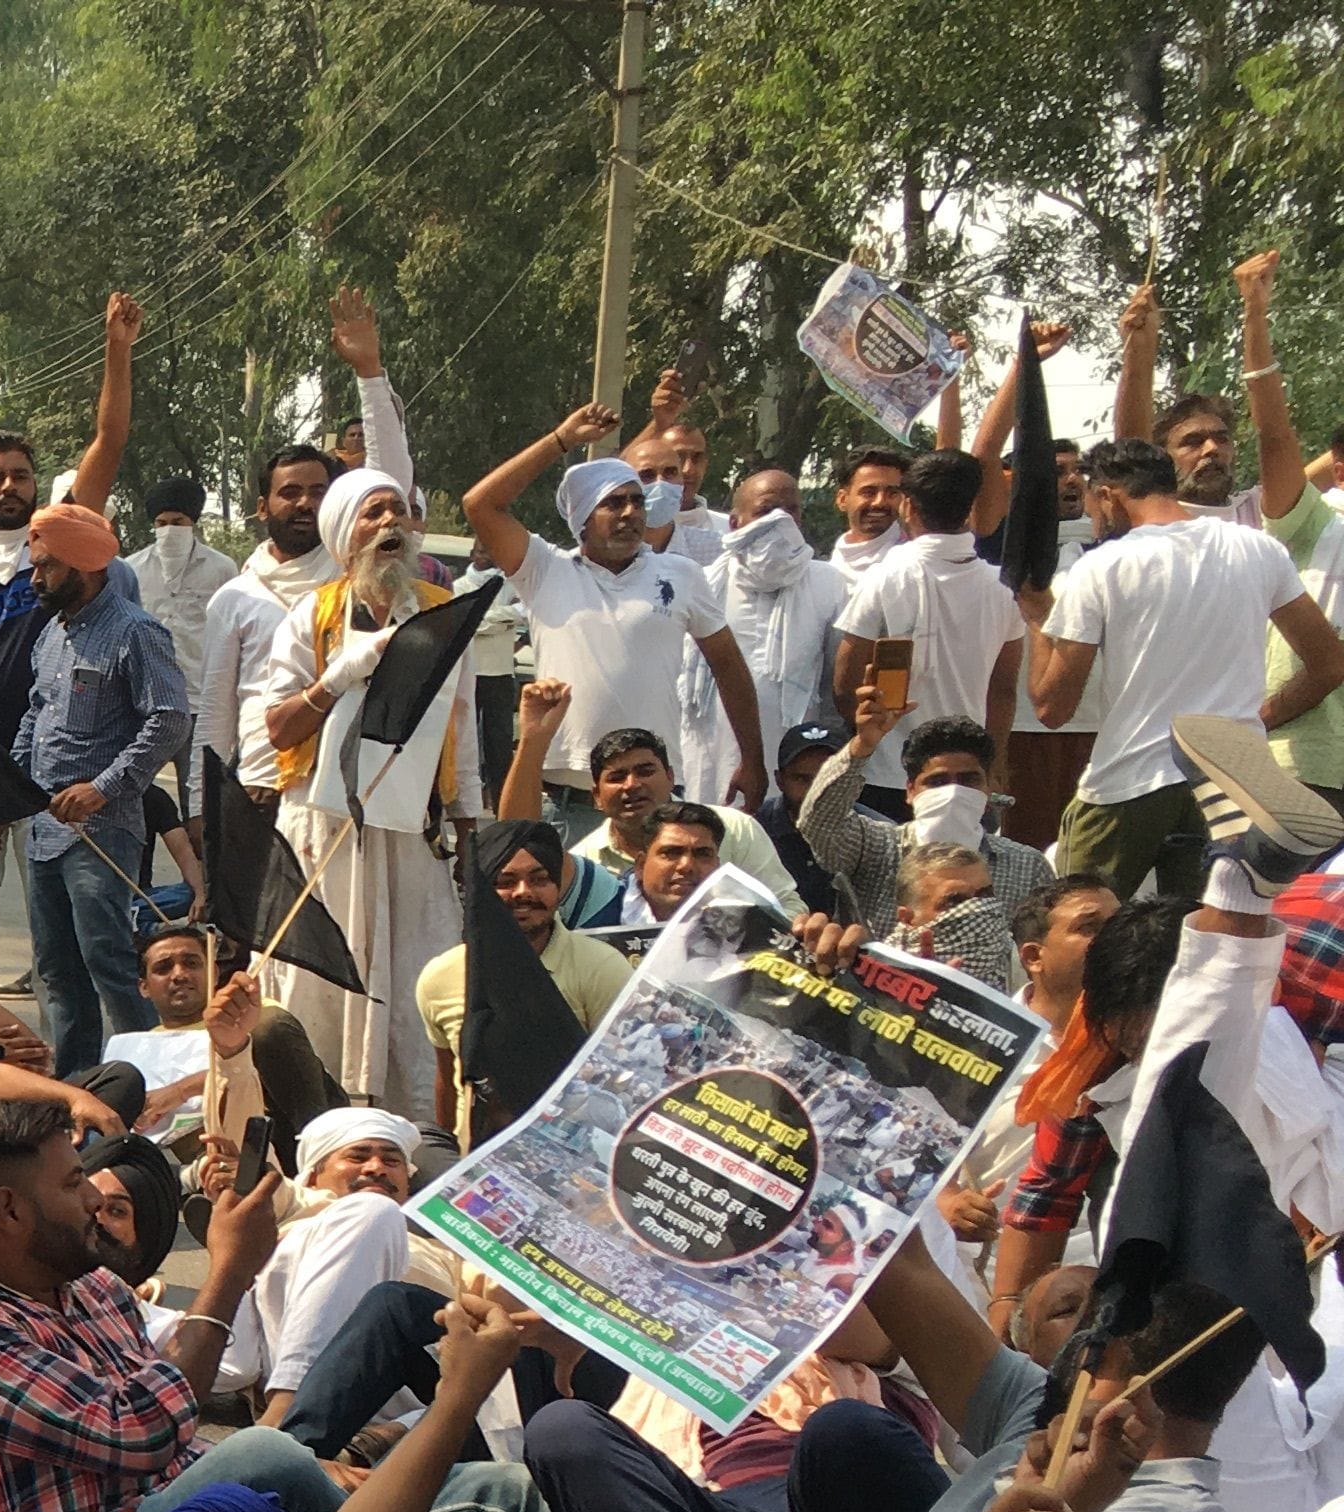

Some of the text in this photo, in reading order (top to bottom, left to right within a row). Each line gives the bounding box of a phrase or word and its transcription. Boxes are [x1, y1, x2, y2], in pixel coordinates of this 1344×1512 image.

[826, 986, 861, 1015] पर
[857, 1003, 916, 1045] लाठी
[912, 1028, 1003, 1086] चलवाता
[854, 952, 938, 1010] गब्बर
[928, 997, 1018, 1057] कहलाता,
[662, 1098, 679, 1113] हर
[679, 1105, 708, 1127] लाठी
[706, 1118, 725, 1135] का
[721, 1126, 758, 1153] हिसाब
[695, 1081, 808, 1151] किसानों को मारी
[631, 1146, 662, 1168] धरती
[676, 1167, 691, 1184] के
[710, 1188, 730, 1207] की
[726, 1199, 748, 1215] हर
[643, 1175, 676, 1200] अपना
[702, 1148, 719, 1163] का
[702, 1231, 721, 1248] को
[520, 1241, 546, 1262] हम
[542, 1257, 585, 1290] अपना
[579, 1283, 609, 1303] हक
[605, 1297, 641, 1323] लेकर
